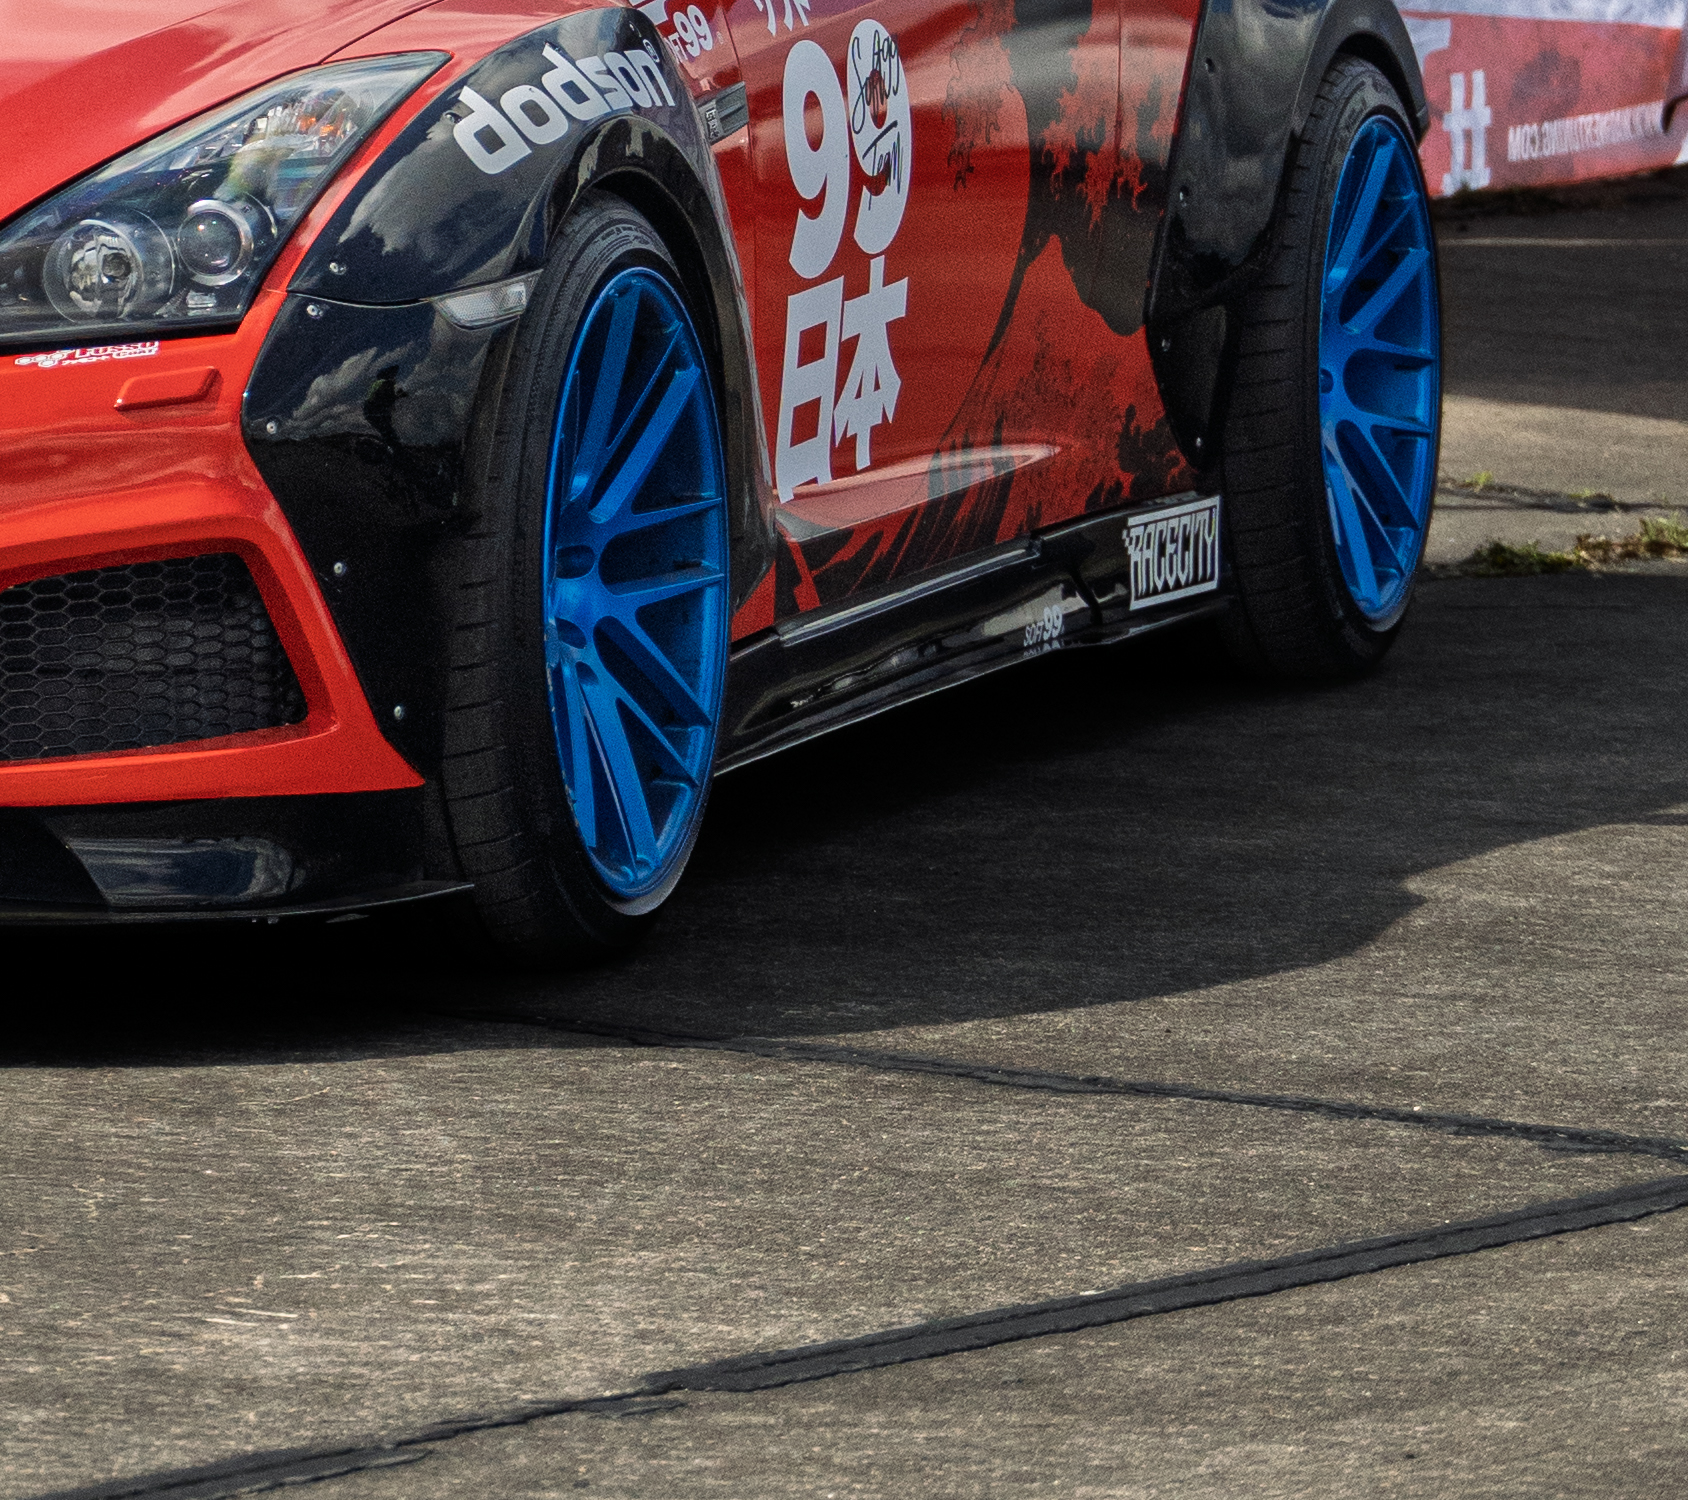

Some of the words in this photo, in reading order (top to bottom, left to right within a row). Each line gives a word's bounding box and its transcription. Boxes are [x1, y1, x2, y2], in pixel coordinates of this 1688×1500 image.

[783, 18, 912, 279] 99
[775, 254, 909, 504] 日本
[1127, 507, 1217, 597] RACECITY
